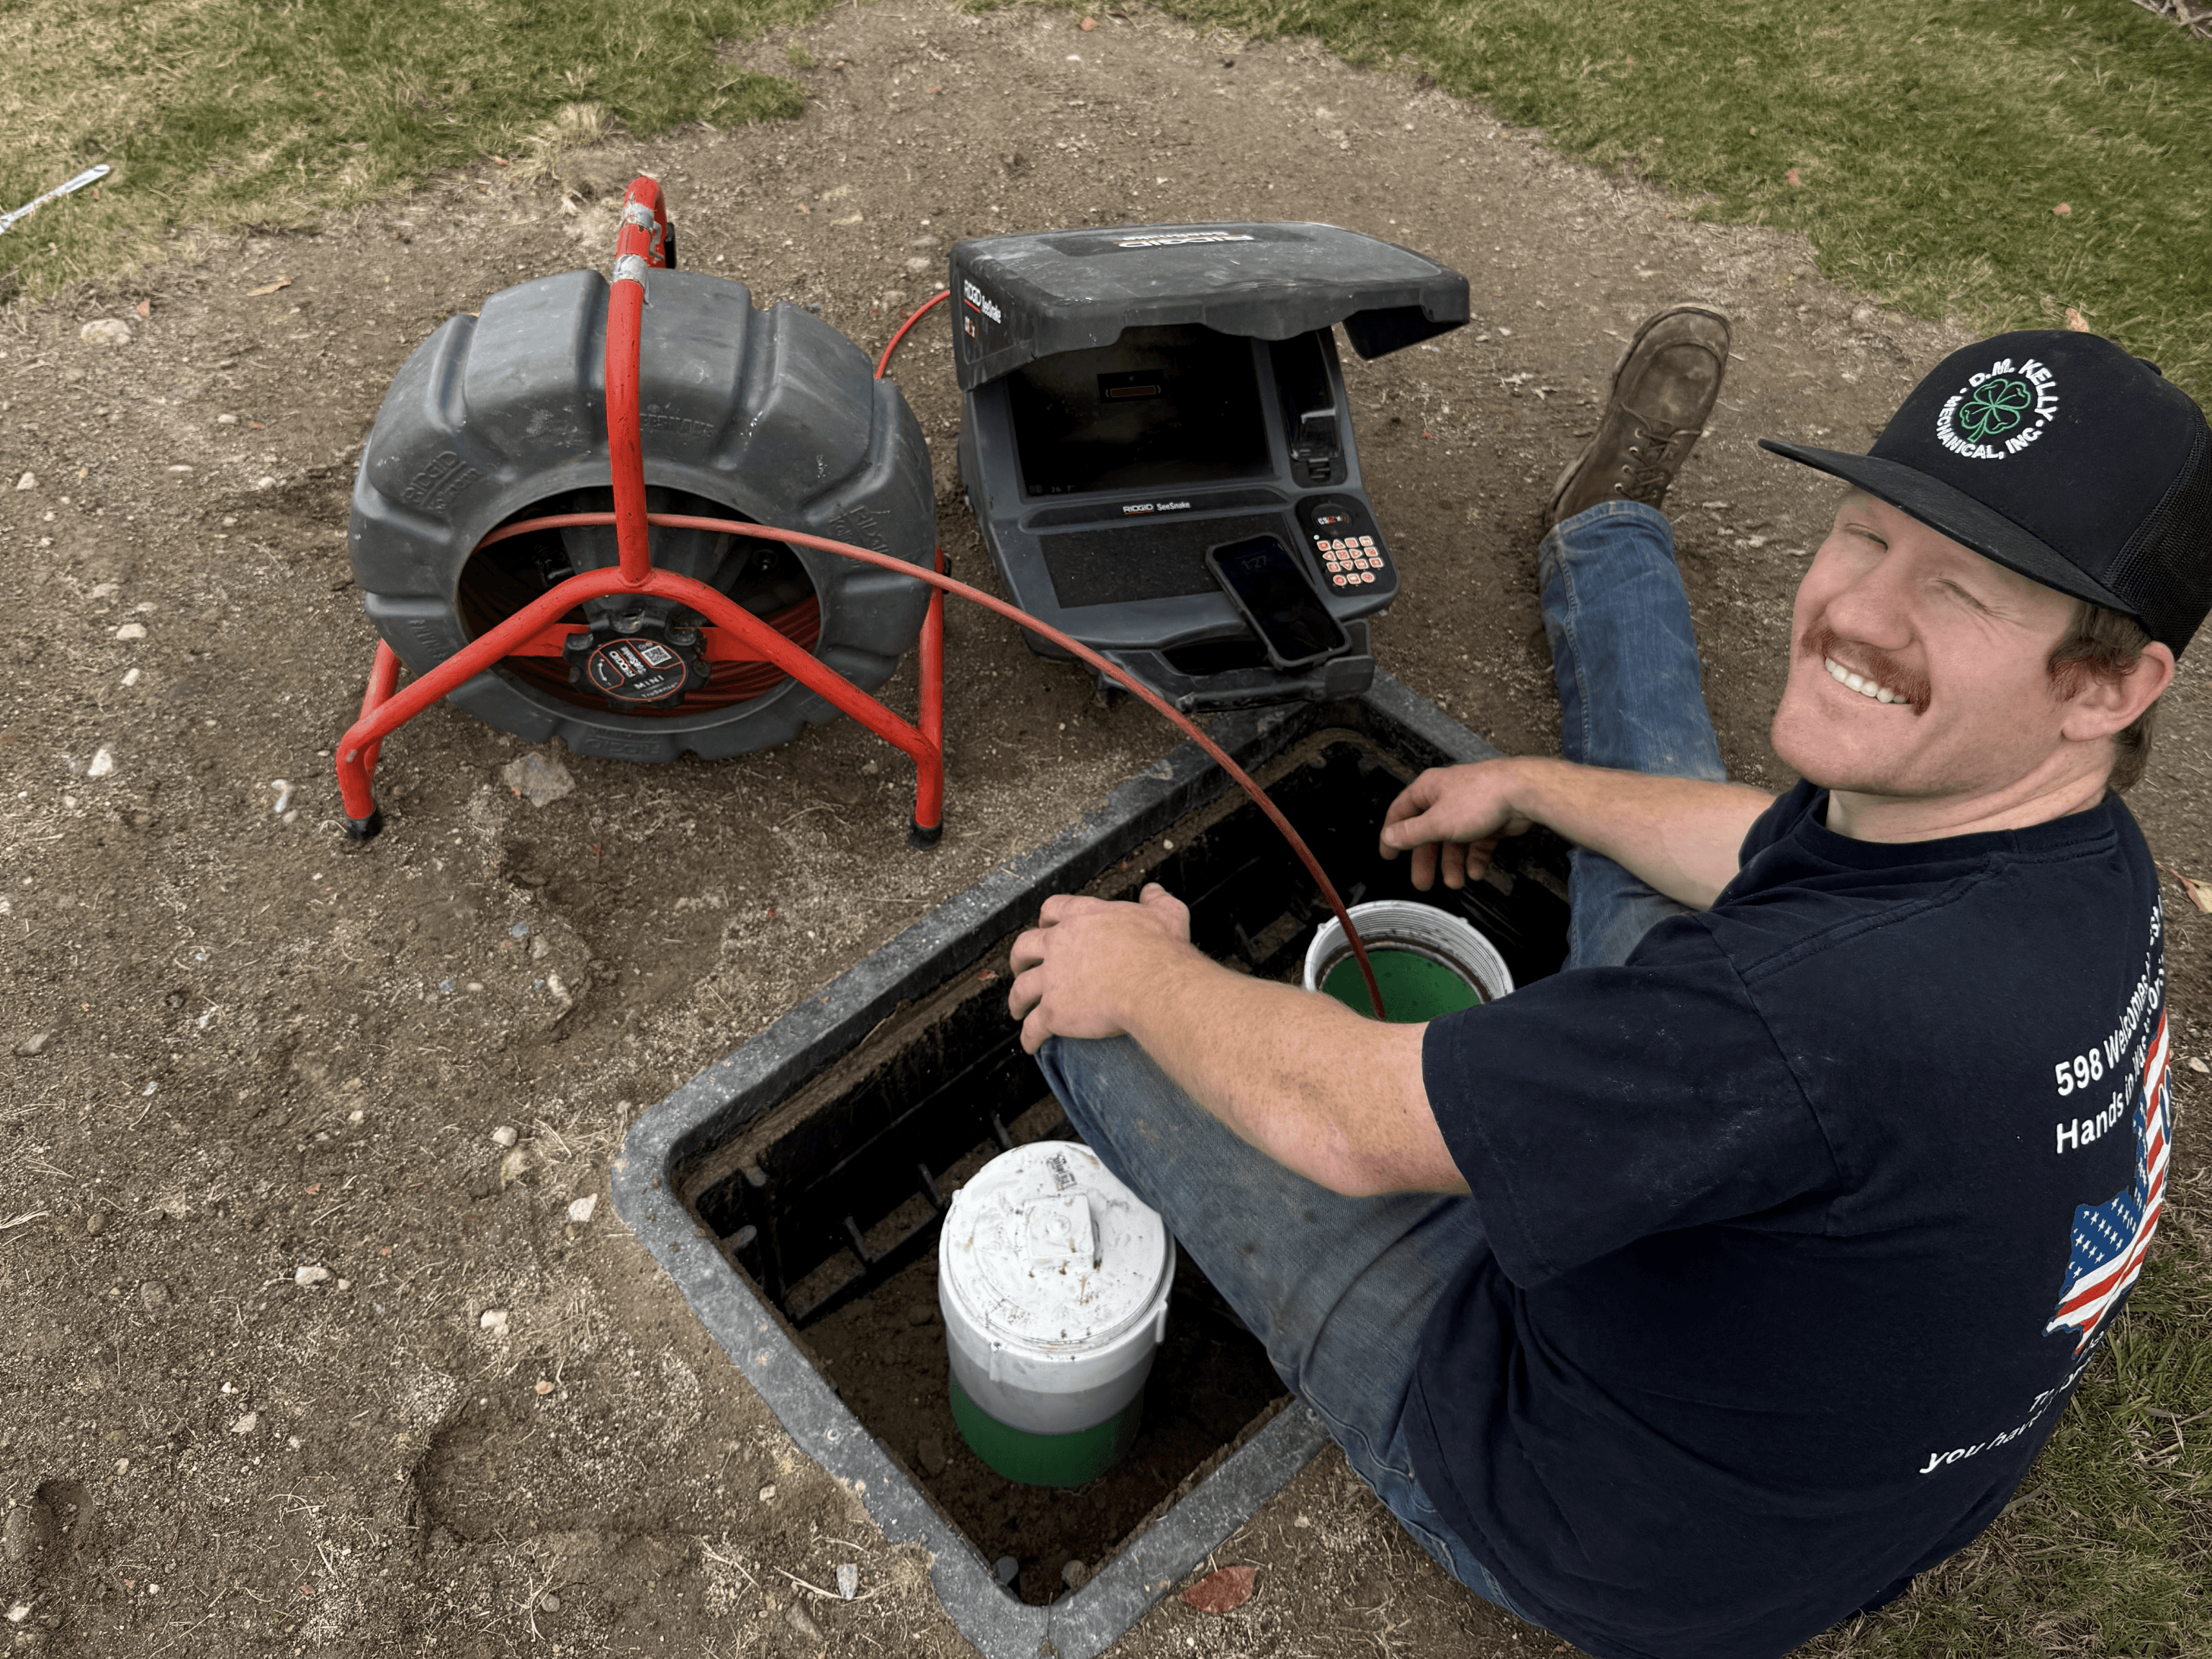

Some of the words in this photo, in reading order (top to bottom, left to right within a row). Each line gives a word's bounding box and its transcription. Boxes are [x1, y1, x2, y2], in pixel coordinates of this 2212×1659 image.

[1969, 358, 2016, 387] D.M.
[2018, 359, 2059, 422] KELLY
[402, 451, 459, 503] RIDGID
[1123, 503, 1154, 513] RIDGID
[1156, 502, 1190, 511] SeeSnake
[609, 650, 637, 678] RIDGID
[621, 646, 646, 675] SeeSnake
[634, 675, 665, 689] MINI
[2055, 1048, 2103, 1097] 598
[2056, 1091, 2124, 1154] Hands
[2123, 1072, 2135, 1107] in
[1919, 1442, 1986, 1474] you
